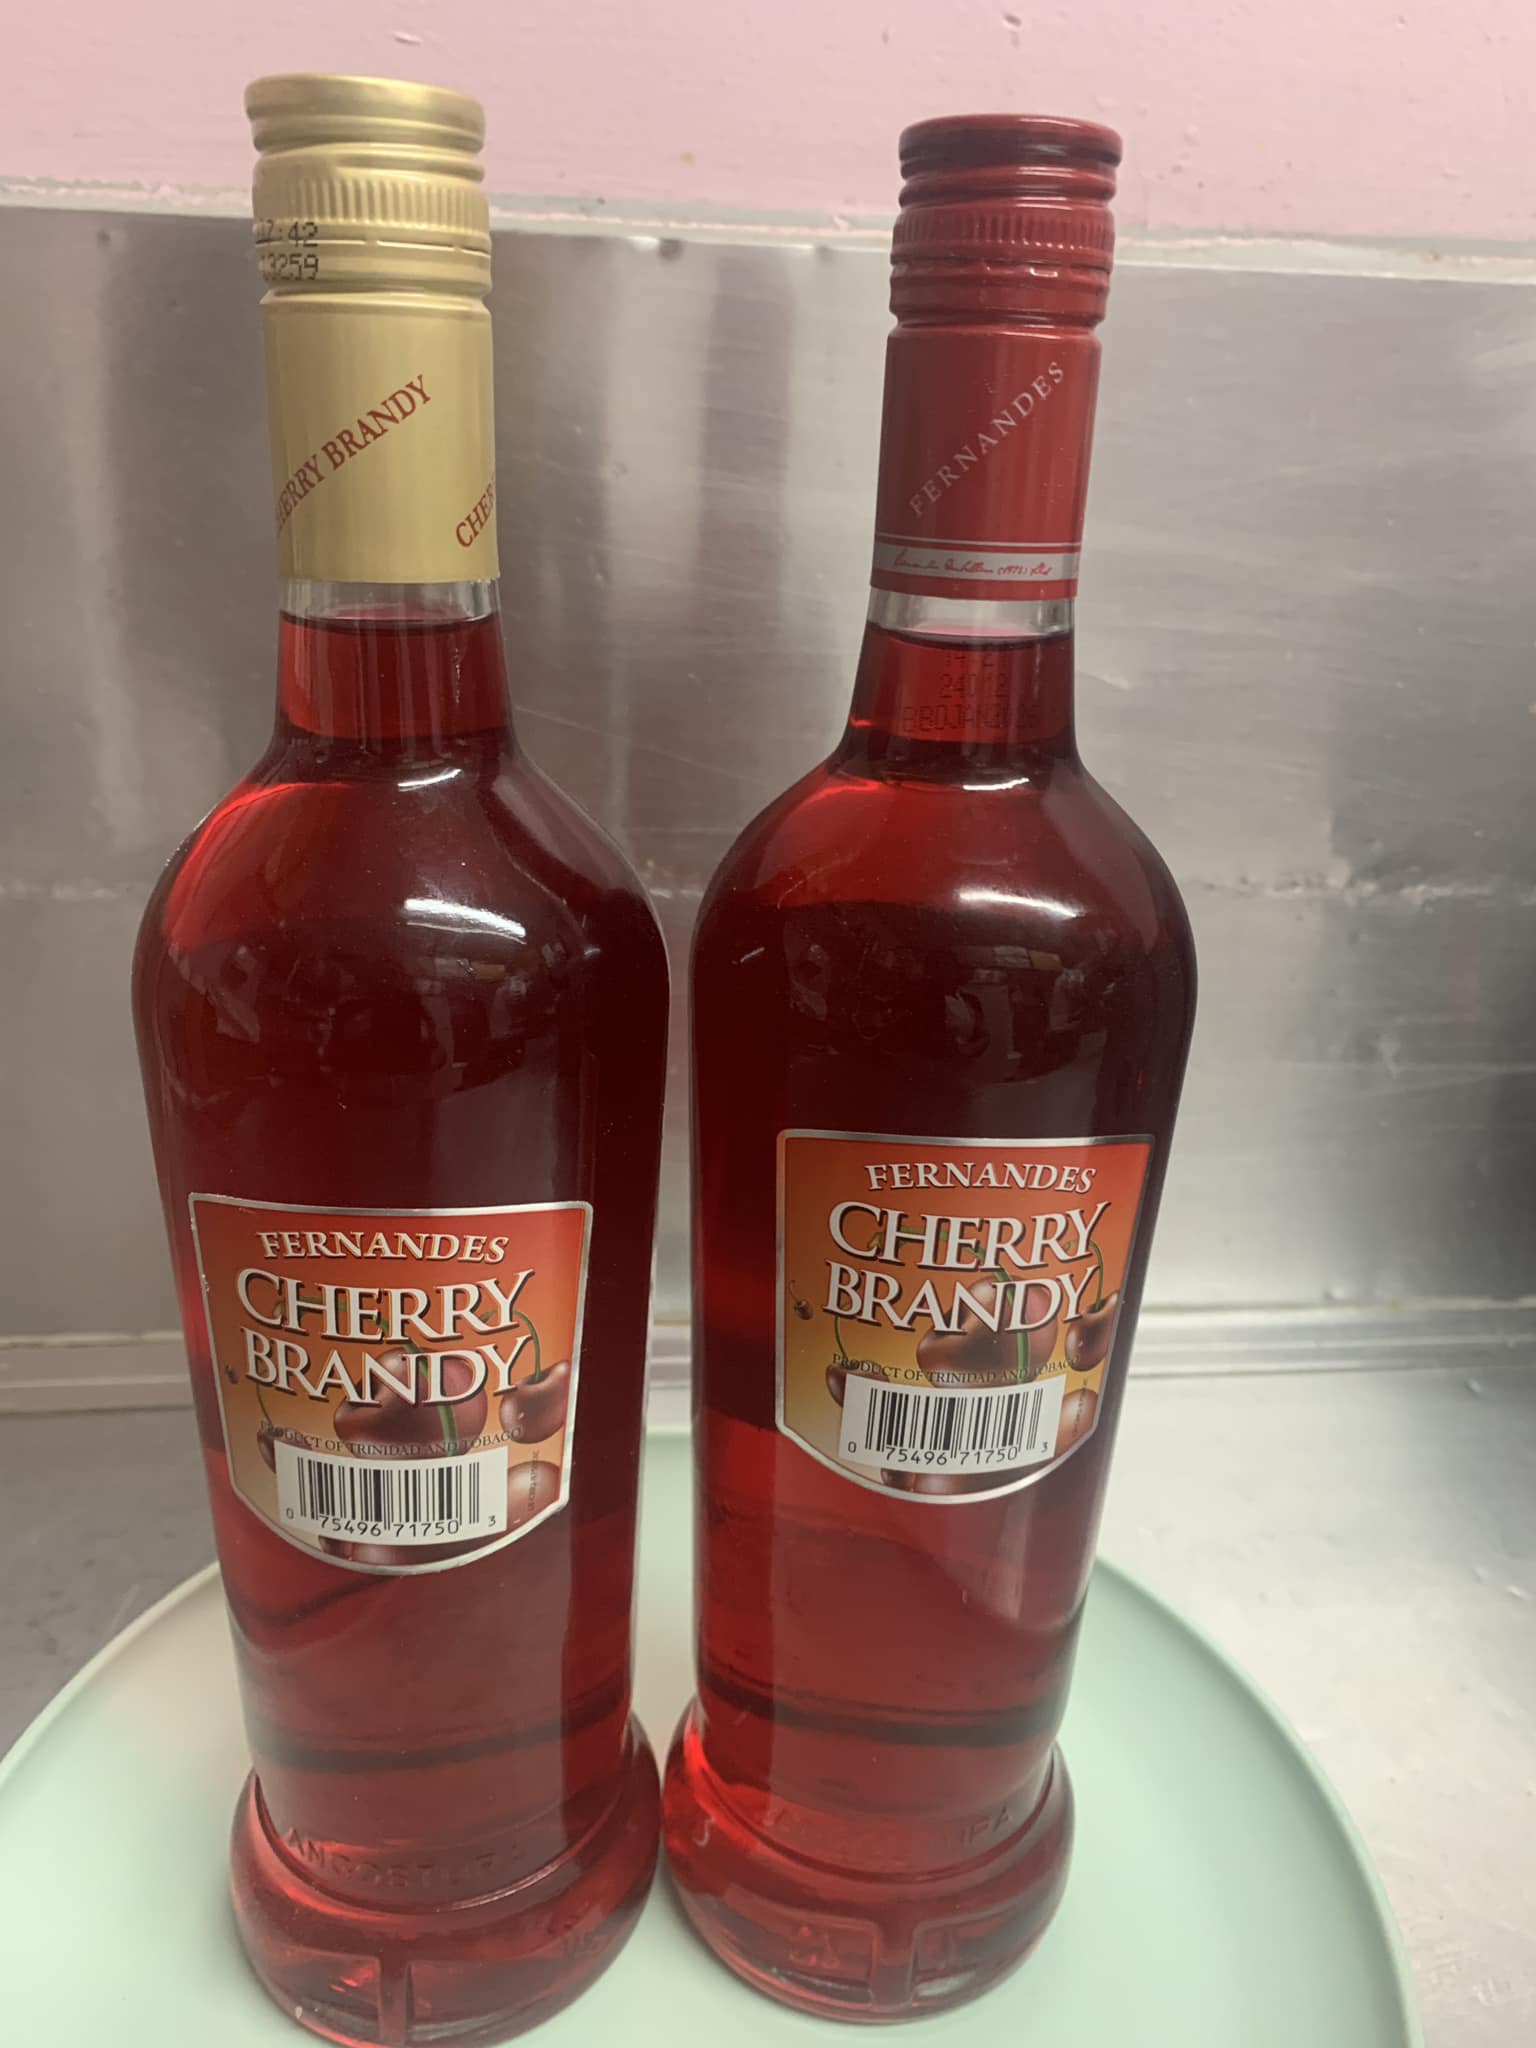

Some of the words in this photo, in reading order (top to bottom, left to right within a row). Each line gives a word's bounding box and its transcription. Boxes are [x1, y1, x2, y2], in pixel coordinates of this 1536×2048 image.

[321, 374, 431, 470] BRANDY
[909, 361, 1065, 518] FERNANDES
[864, 1162, 1096, 1194] FERNANDES
[255, 1230, 510, 1264] FERNANDES
[828, 1200, 1110, 1271] CHERRY
[236, 1267, 534, 1344] CHERRY
[823, 1260, 1100, 1335] BRANDY
[240, 1327, 533, 1408] BRANDY
[832, 1354, 901, 1379] PRODUCT
[904, 1369, 924, 1381] OF
[925, 1371, 996, 1384] TRINIDAD
[260, 1422, 322, 1450] PRODUCT
[325, 1440, 345, 1451] OF
[347, 1442, 420, 1457] TRINIDAD
[423, 1439, 458, 1453] AND
[460, 1426, 521, 1451] TOBAGO
[847, 1441, 857, 1454] 0
[885, 1446, 948, 1466] 75496
[960, 1447, 1018, 1465] 71750
[1040, 1441, 1048, 1453] 3
[286, 1507, 295, 1520] 0
[318, 1513, 382, 1538] 75496
[394, 1520, 459, 1538] 71750
[488, 1515, 497, 1528] 3
